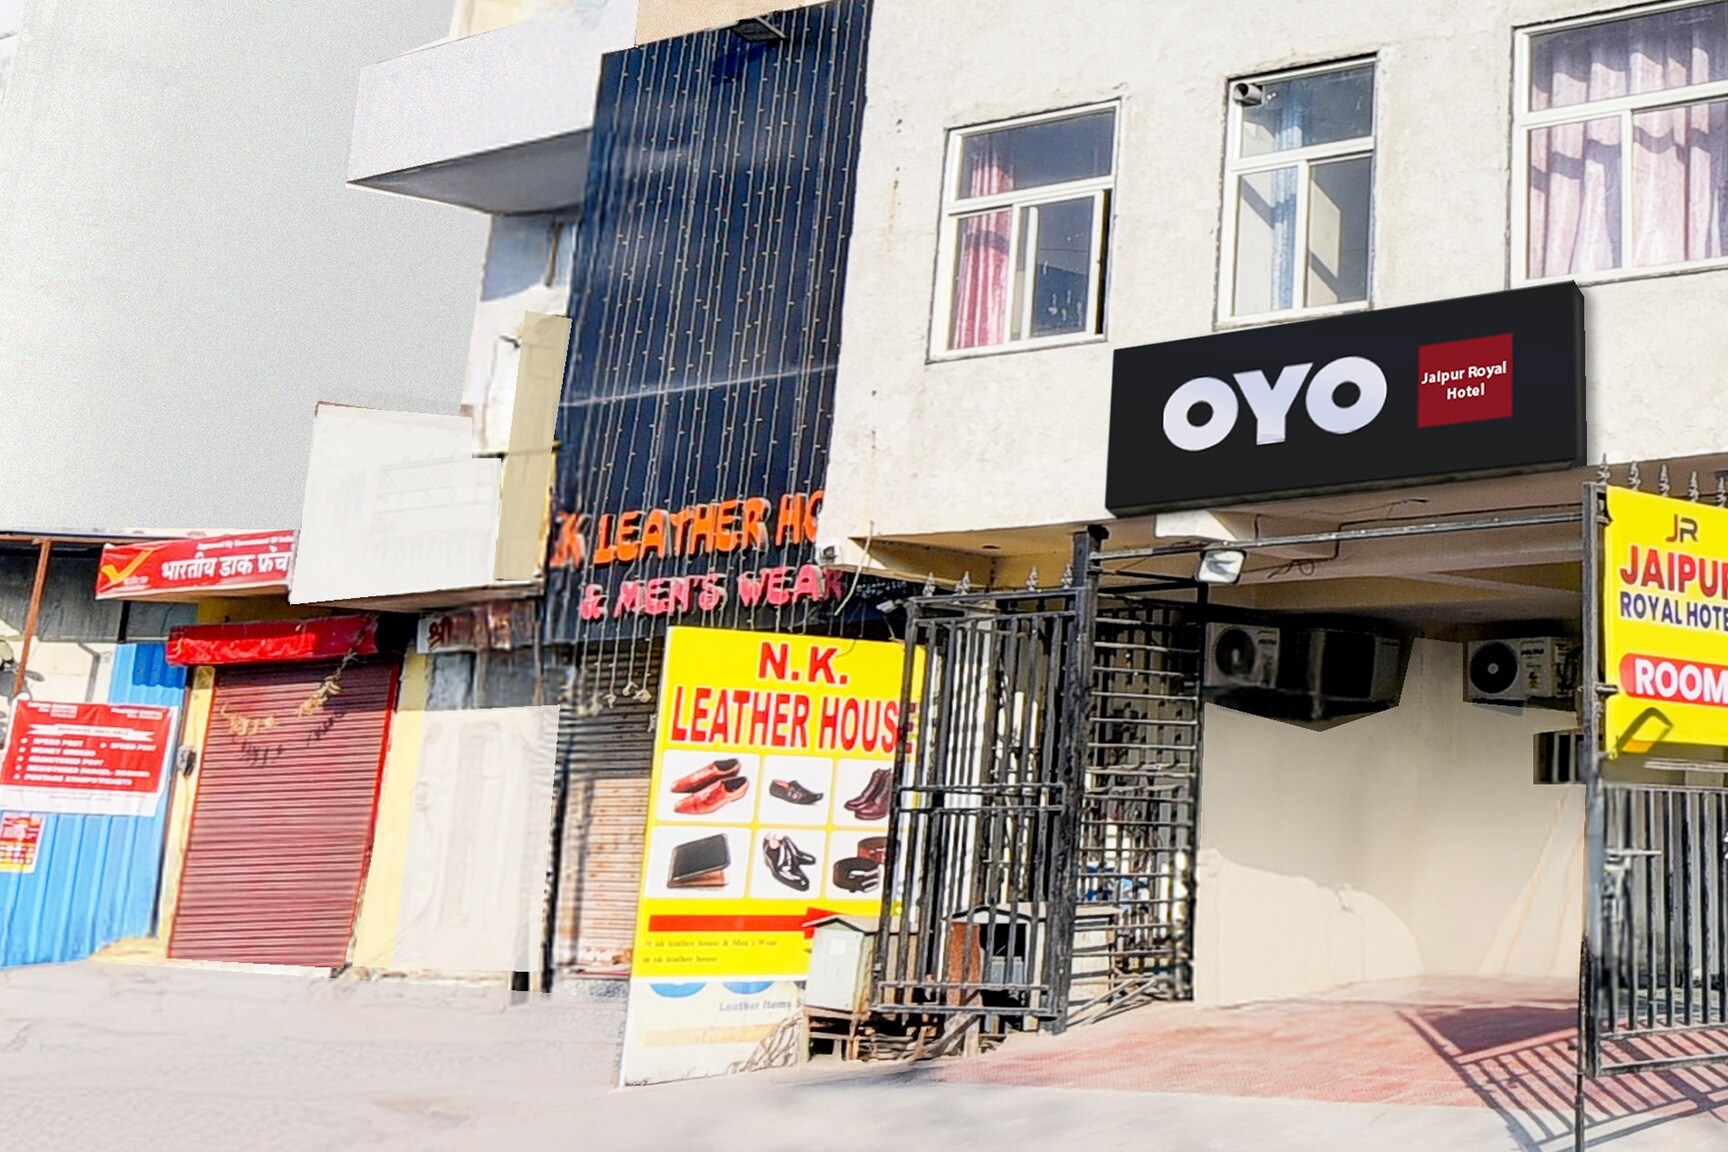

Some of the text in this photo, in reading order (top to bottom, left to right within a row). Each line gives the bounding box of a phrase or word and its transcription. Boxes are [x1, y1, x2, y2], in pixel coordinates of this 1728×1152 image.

[1468, 360, 1507, 379] Royal
[1162, 356, 1388, 451] OYO
[1446, 382, 1485, 400] Hotel
[593, 497, 771, 564] LEATHER
[1665, 513, 1699, 543] JR
[162, 552, 218, 580] भारतीय
[219, 554, 256, 577] डाक
[614, 573, 726, 617] MEN'S
[738, 564, 845, 608] WEAR
[1620, 591, 1683, 625] ROYAL
[671, 686, 811, 748] LEATHER
